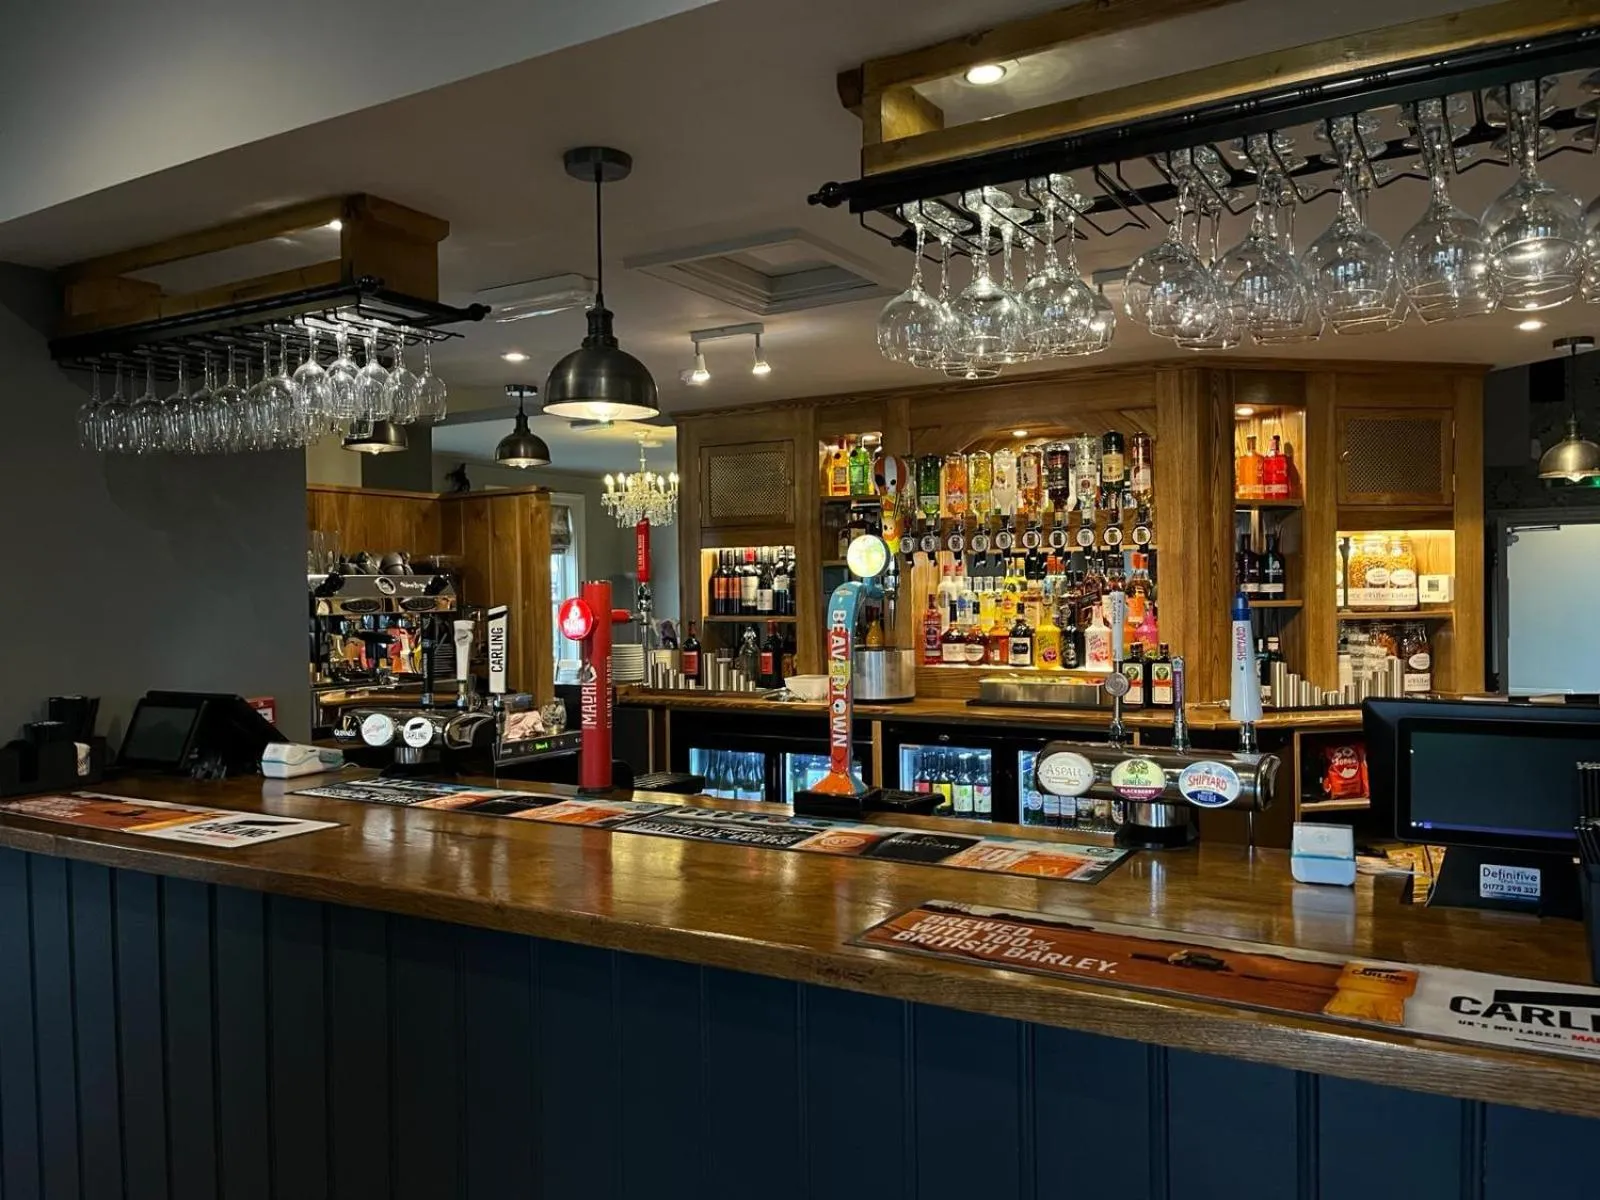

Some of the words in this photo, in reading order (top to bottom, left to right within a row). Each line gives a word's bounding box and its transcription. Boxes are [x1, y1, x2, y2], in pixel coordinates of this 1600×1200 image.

[491, 627, 503, 673] CARLING
[832, 610, 847, 747] BEAVERTOWN
[1187, 774, 1228, 791] SHIPYARD
[1483, 867, 1538, 882] Definitive
[1483, 883, 1504, 891] 01772
[910, 922, 974, 940] WITH
[982, 932, 1056, 951] 100%
[922, 915, 1035, 937] BREWED
[892, 931, 1000, 954] BRITISH
[1003, 947, 1119, 974] BARLEY.
[1352, 970, 1408, 981] CARLING
